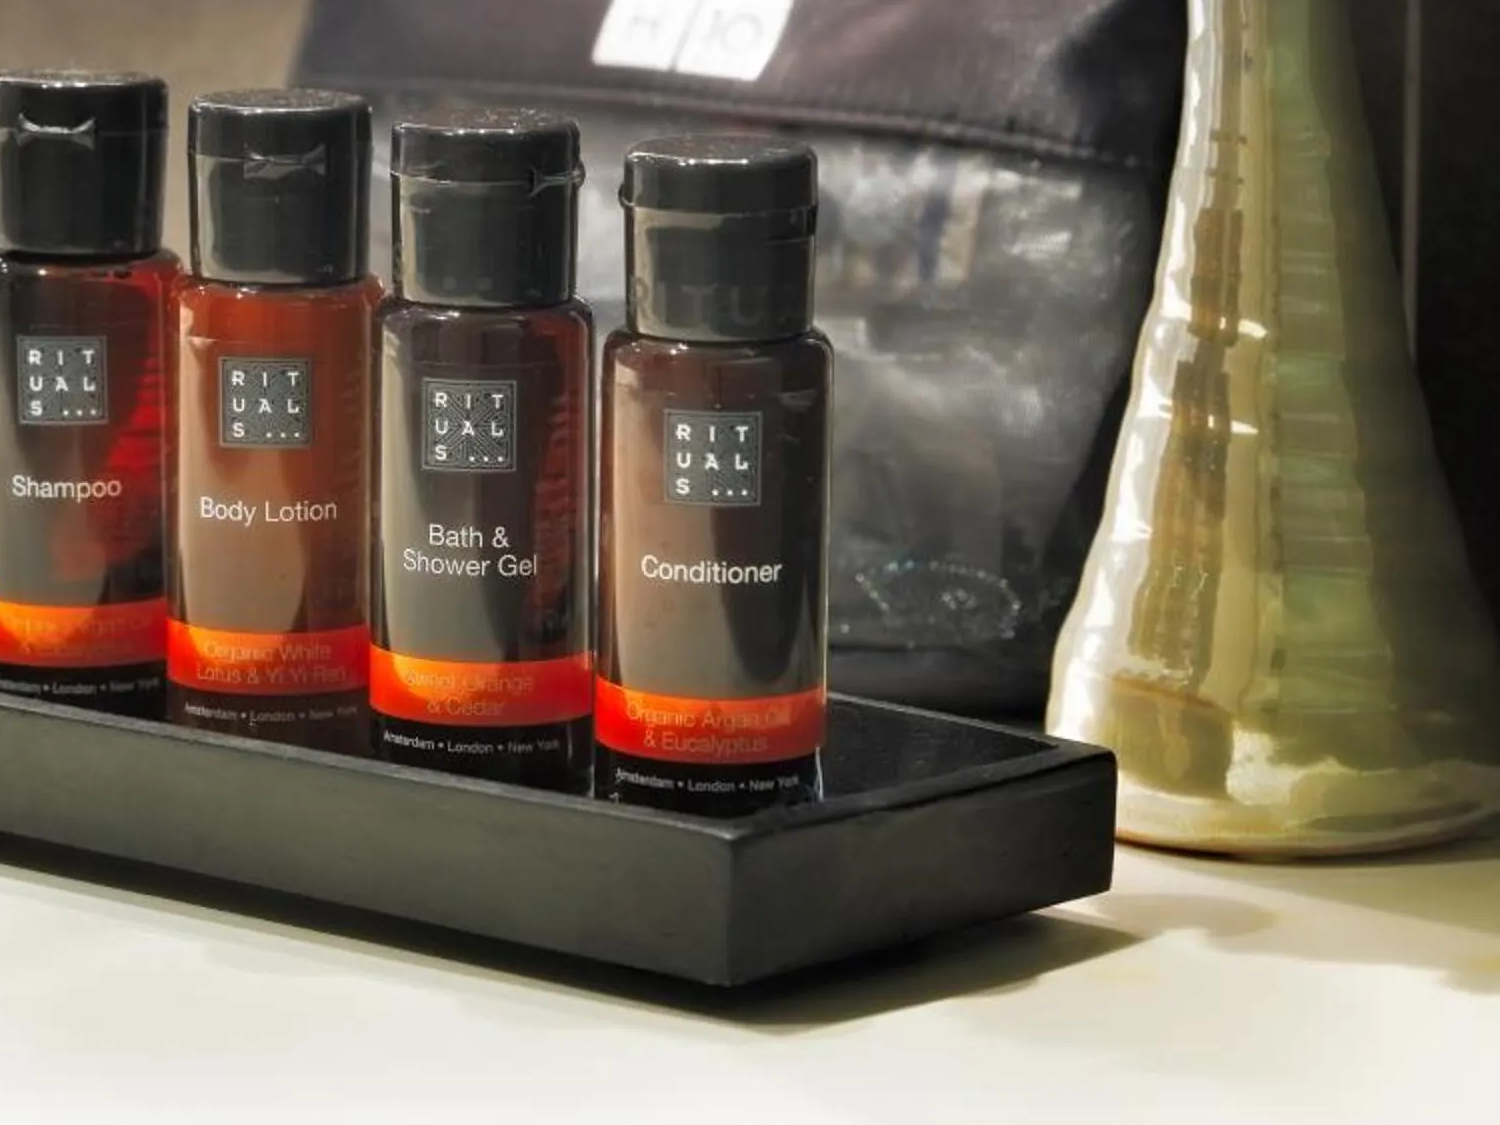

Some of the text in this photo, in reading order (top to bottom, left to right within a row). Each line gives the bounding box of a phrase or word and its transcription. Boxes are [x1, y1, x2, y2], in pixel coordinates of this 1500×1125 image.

[11, 475, 123, 505] Shampoo
[199, 496, 338, 527] Body Lotion
[428, 523, 510, 550] Bath &
[402, 546, 539, 578] Shower Gel
[640, 553, 783, 585] Conditioner
[278, 642, 333, 660] White
[196, 665, 242, 683] Lotus
[447, 740, 495, 754] London
[643, 730, 769, 758] & Eucalyptus
[686, 777, 737, 793] London
